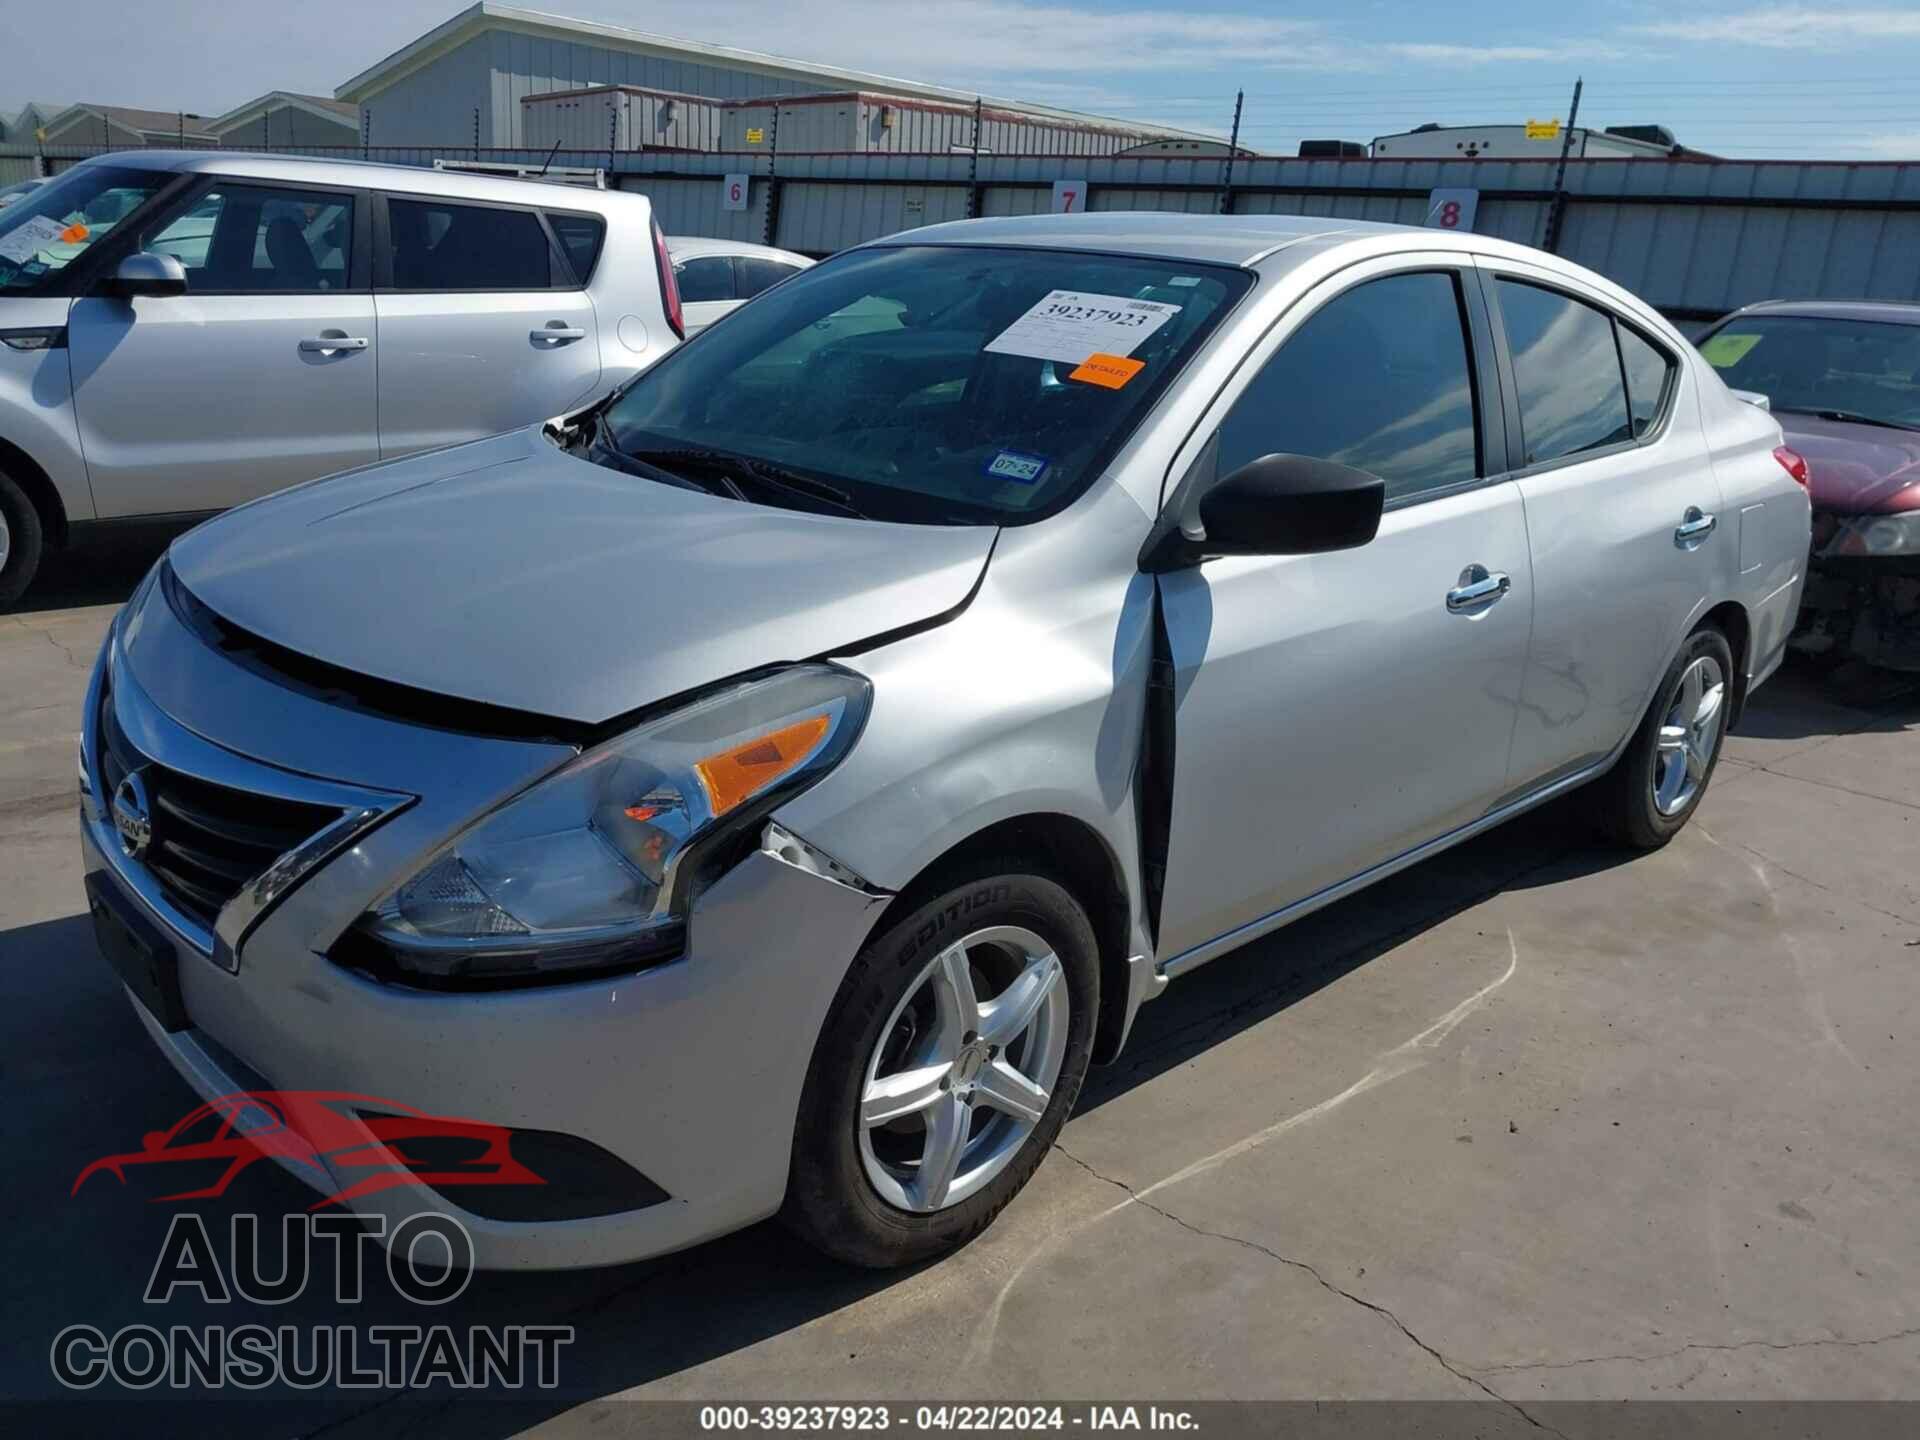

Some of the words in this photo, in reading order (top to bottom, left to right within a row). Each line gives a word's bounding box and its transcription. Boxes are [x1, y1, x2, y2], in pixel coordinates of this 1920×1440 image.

[730, 184, 742, 202] 6
[1062, 191, 1077, 213] 7
[1440, 200, 1461, 227] 8
[1039, 303, 1149, 327] 39237923
